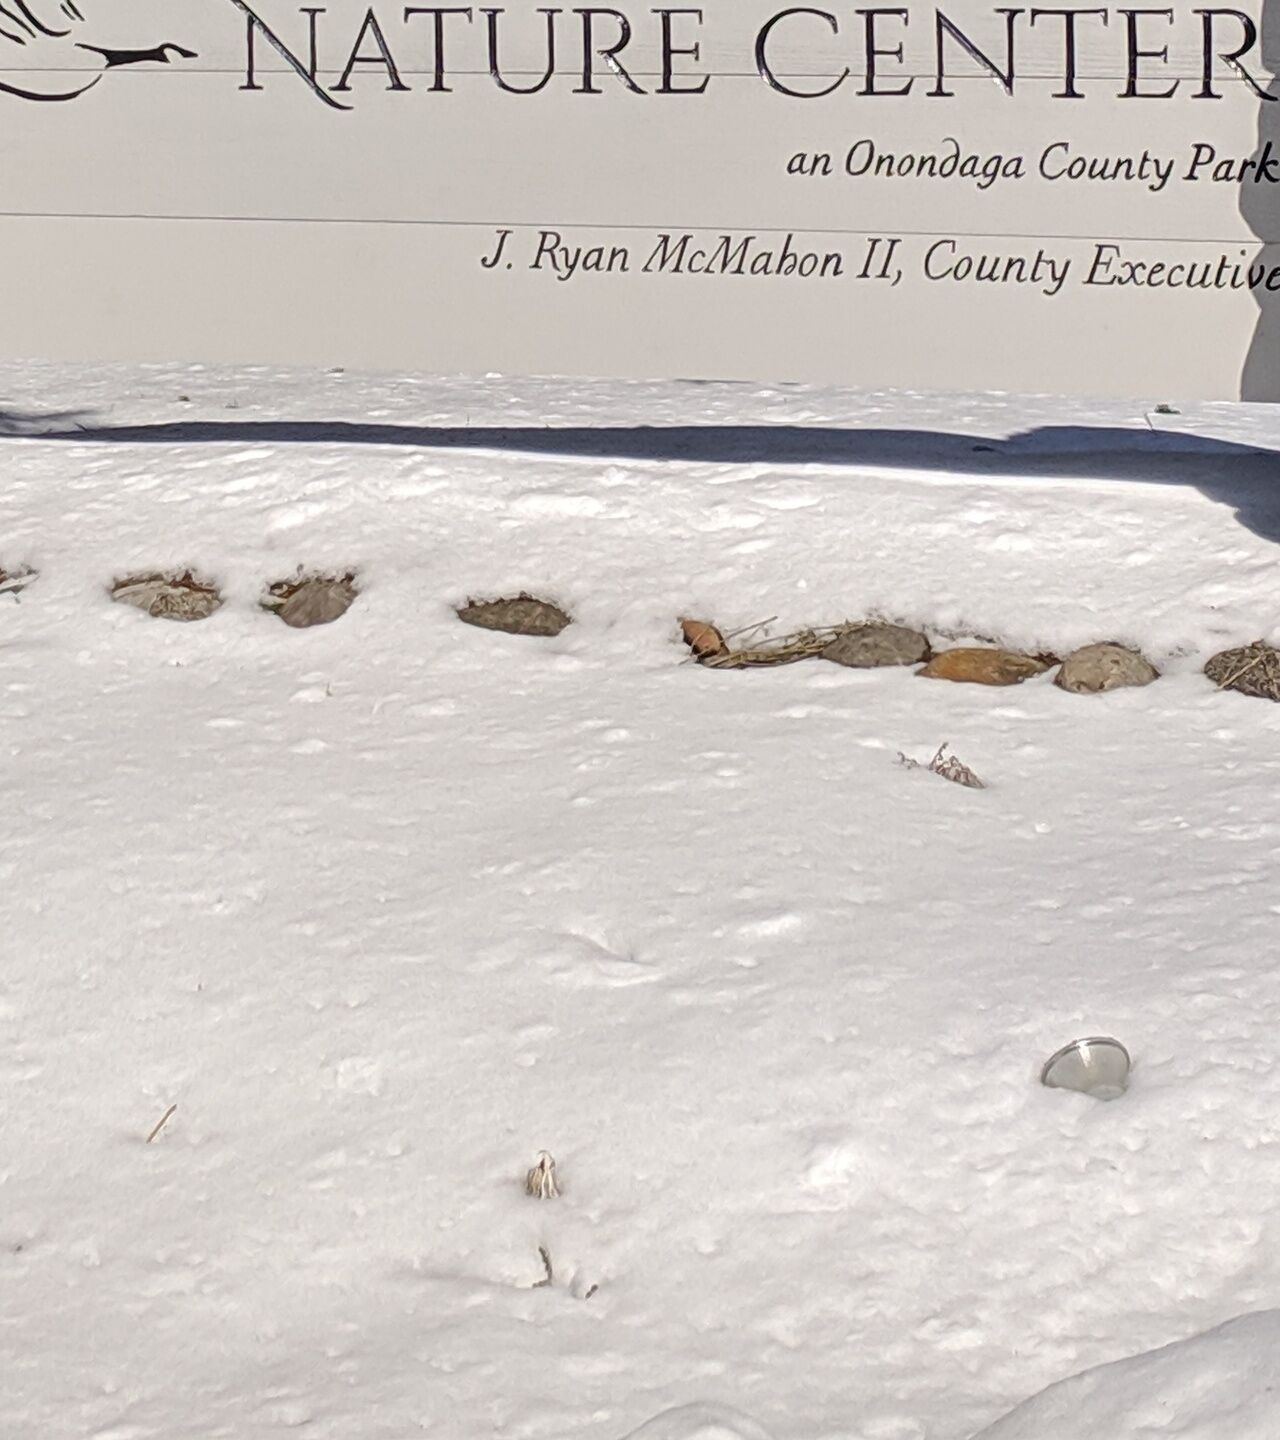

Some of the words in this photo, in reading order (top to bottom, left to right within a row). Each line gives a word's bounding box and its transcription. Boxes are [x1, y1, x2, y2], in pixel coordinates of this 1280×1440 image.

[754, 7, 1280, 102] CENTER
[786, 152, 833, 177] an
[845, 138, 1025, 189] Onondaga
[1039, 142, 1175, 192] County
[1182, 142, 1280, 184] Park
[480, 229, 514, 269] J.
[529, 231, 629, 281] Ryan
[641, 234, 845, 278] McMahon
[856, 238, 903, 287] II,
[924, 240, 1072, 296] County
